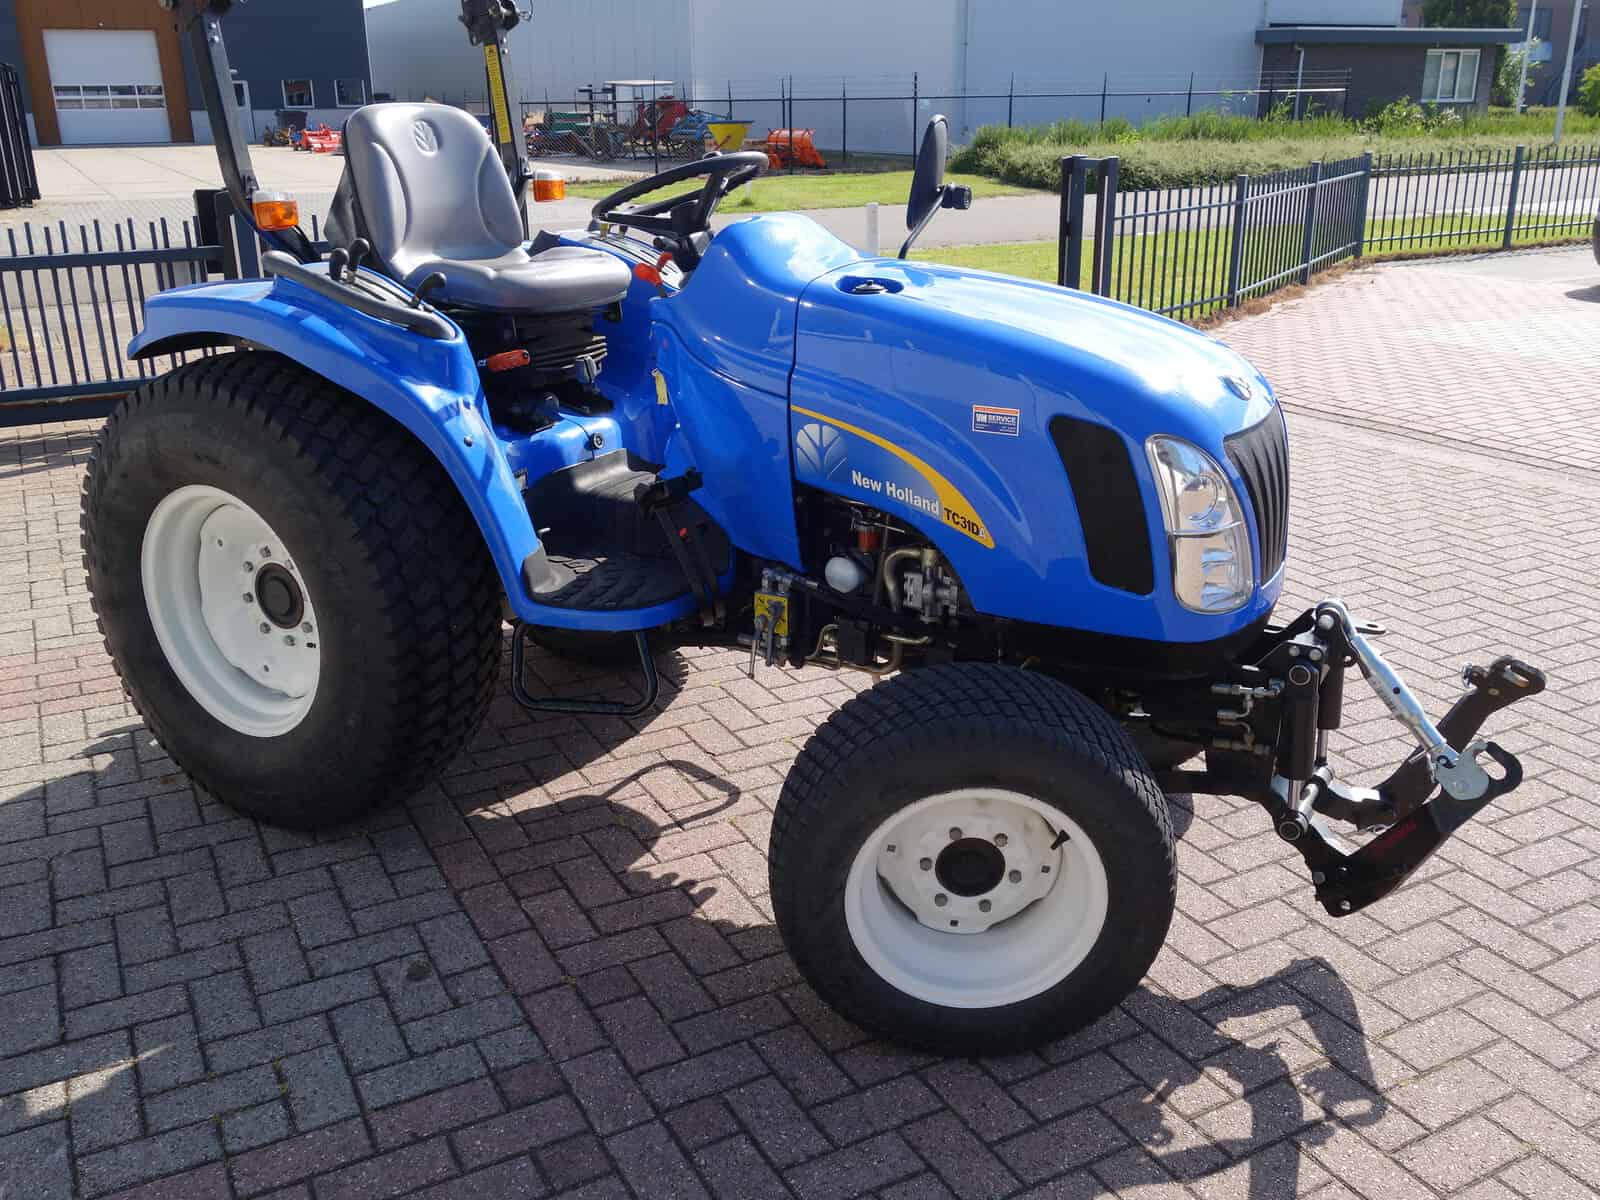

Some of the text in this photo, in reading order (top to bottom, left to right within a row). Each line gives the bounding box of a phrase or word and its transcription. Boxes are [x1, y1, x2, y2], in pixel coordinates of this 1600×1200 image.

[988, 414, 1017, 424] SERVICE
[852, 470, 939, 516] New Holland
